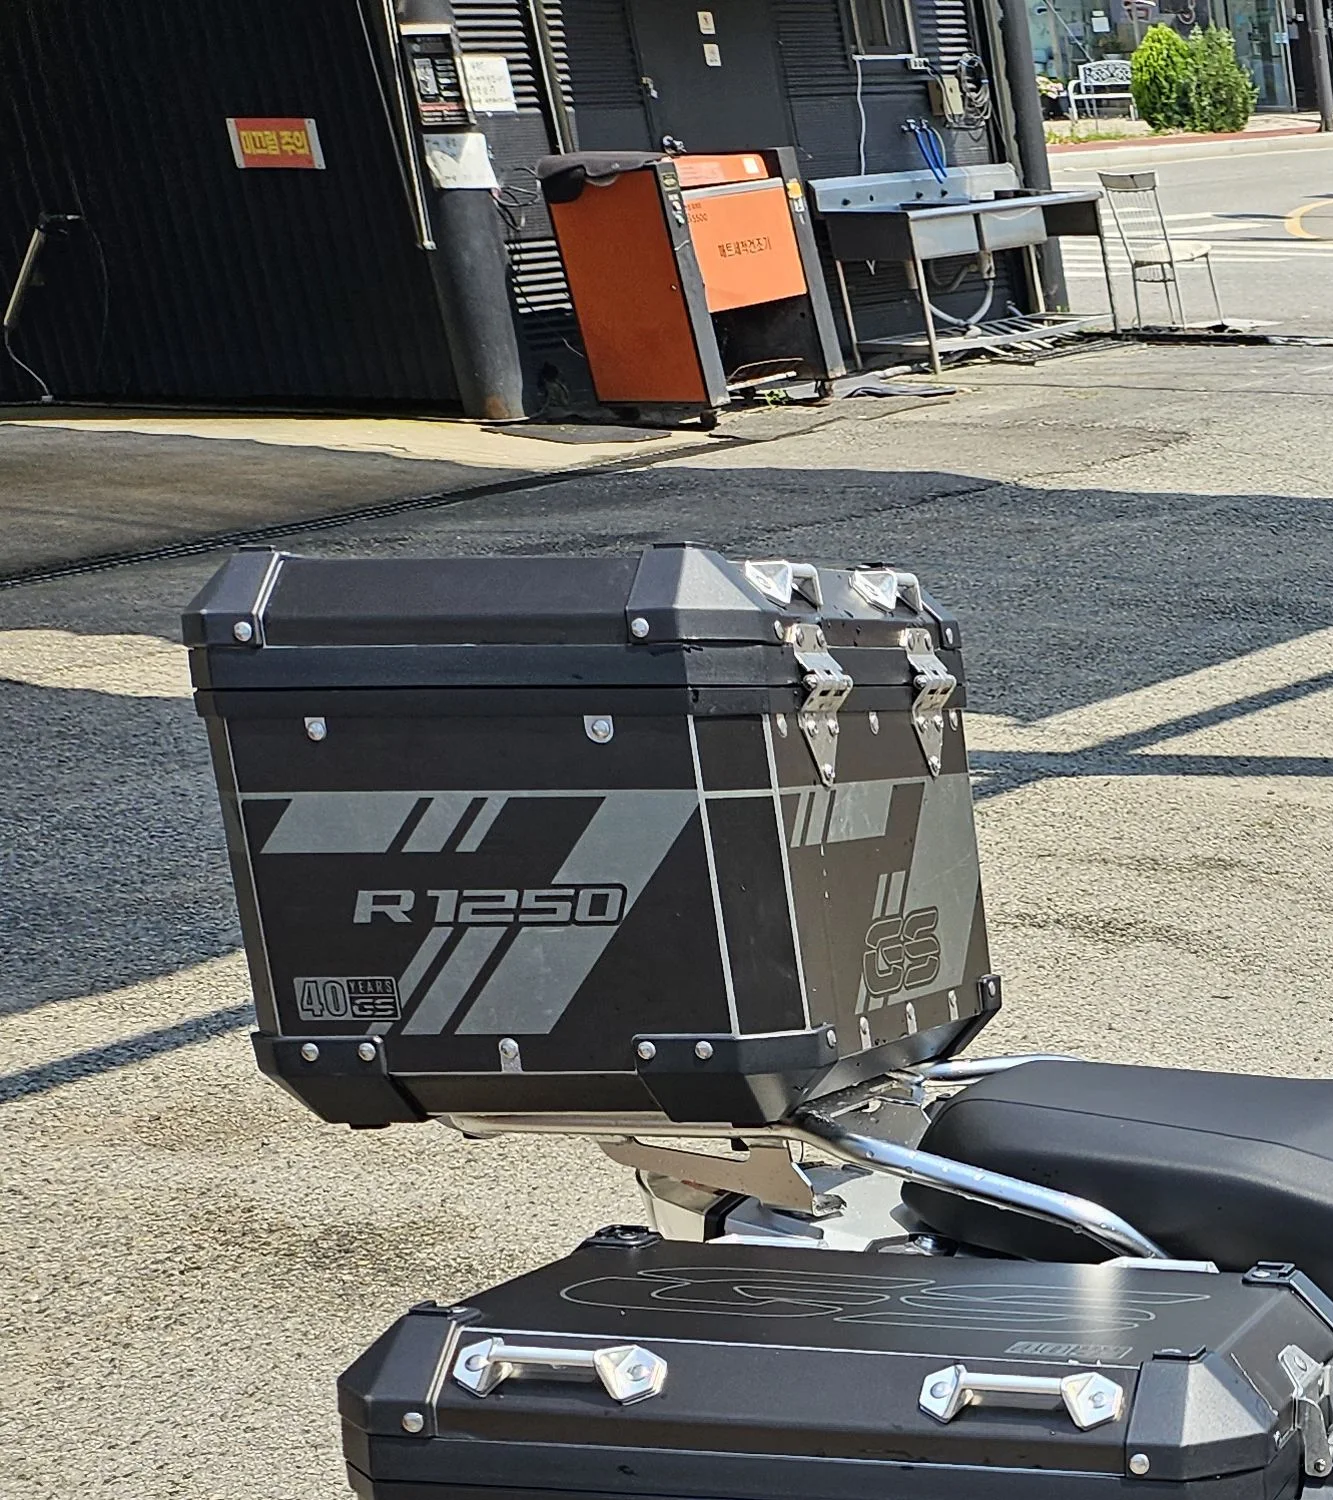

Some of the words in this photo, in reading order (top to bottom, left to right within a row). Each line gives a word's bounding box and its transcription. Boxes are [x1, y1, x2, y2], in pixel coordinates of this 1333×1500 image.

[240, 130, 280, 154] 미끄럼
[280, 130, 309, 155] 주의
[353, 890, 415, 923] R
[427, 888, 625, 924] 1250
[863, 905, 939, 998] GS
[302, 981, 348, 1017] 40
[349, 981, 393, 993] YEARS
